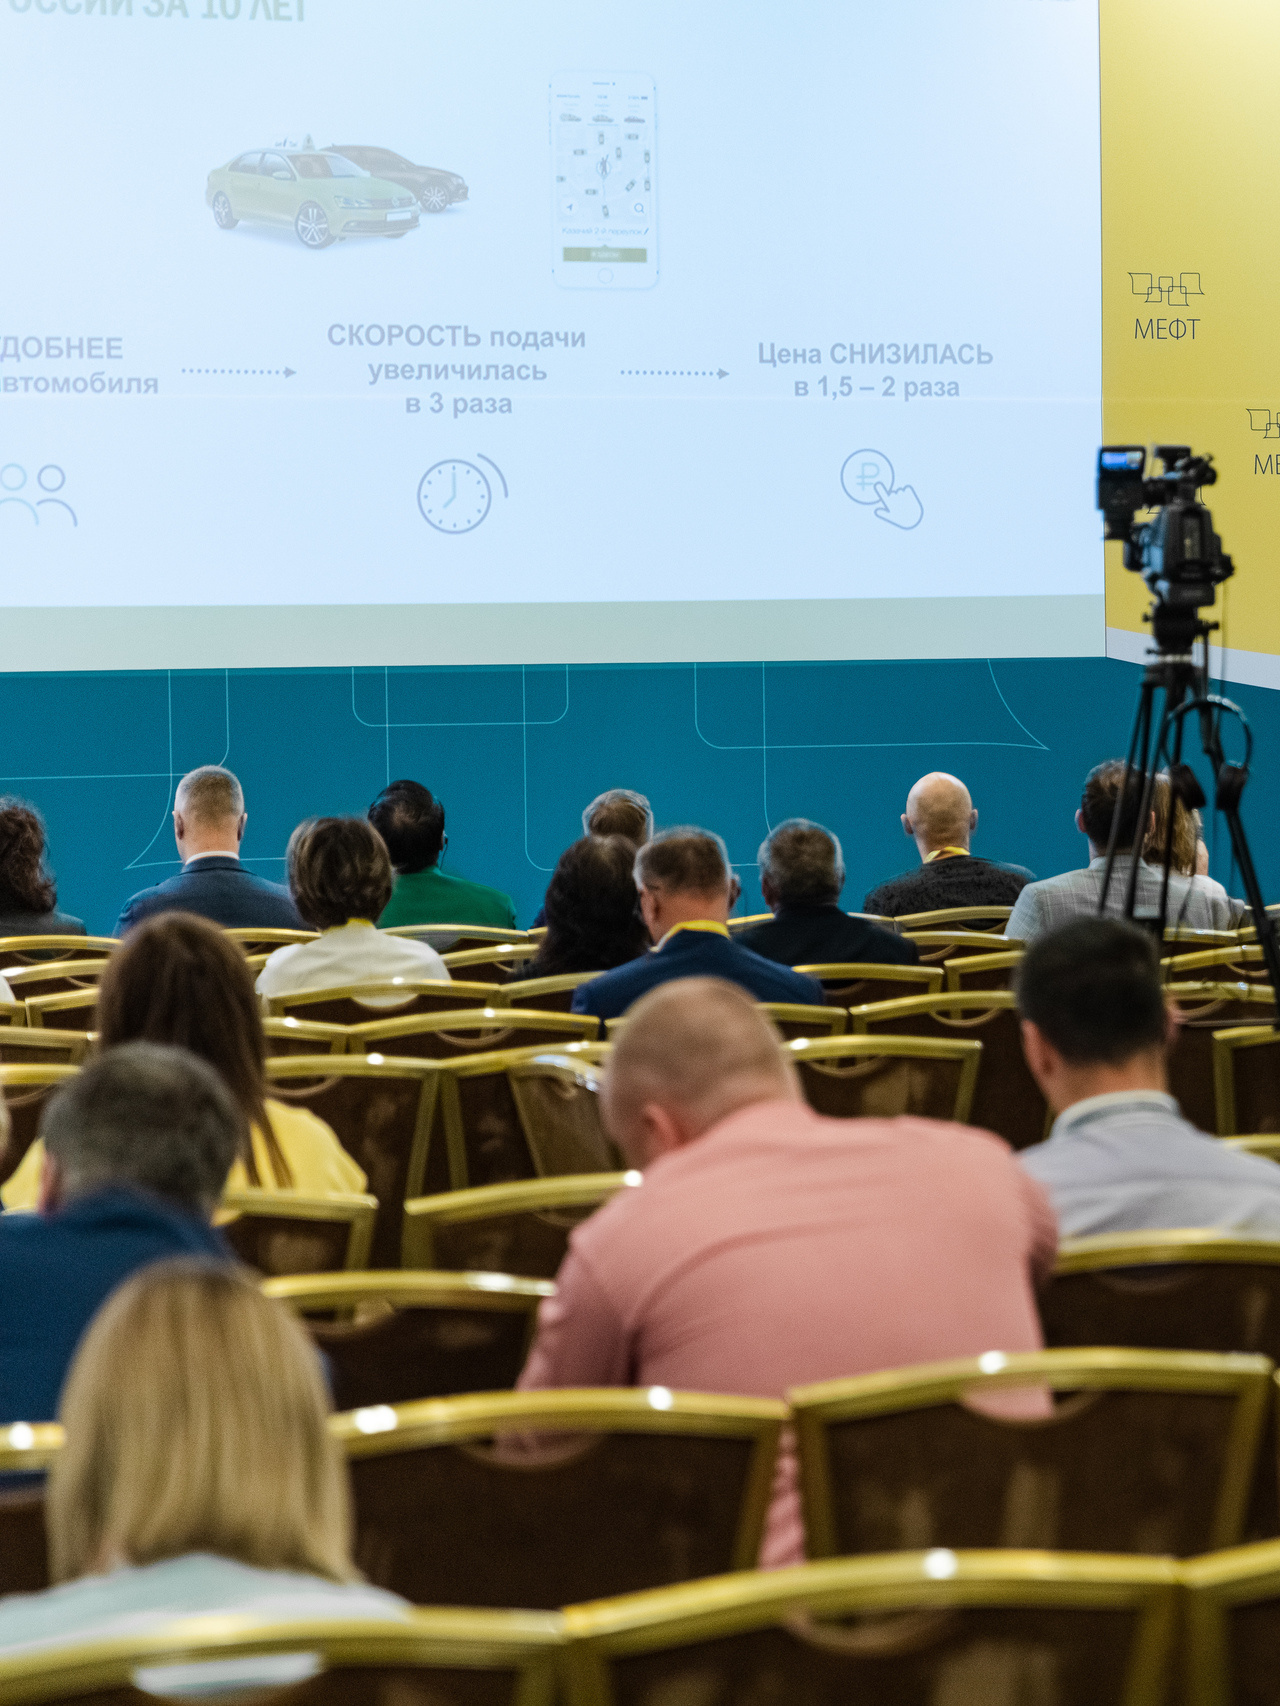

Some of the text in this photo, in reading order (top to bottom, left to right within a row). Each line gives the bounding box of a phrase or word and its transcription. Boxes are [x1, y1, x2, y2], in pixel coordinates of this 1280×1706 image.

[327, 322, 586, 352] СКОРОСТЬ подачи
[1134, 317, 1201, 341] МЕФТ
[0, 335, 124, 364] ДОБНЕЕ
[758, 341, 994, 369] Цена СНИЗИЛАСЬ
[0, 370, 159, 395] втомобиля
[367, 362, 548, 386] увеличилась
[793, 380, 810, 397] в
[817, 374, 854, 401] 1,5
[881, 374, 896, 397] 2
[903, 380, 960, 403] раза
[405, 391, 513, 420] в 3 раза
